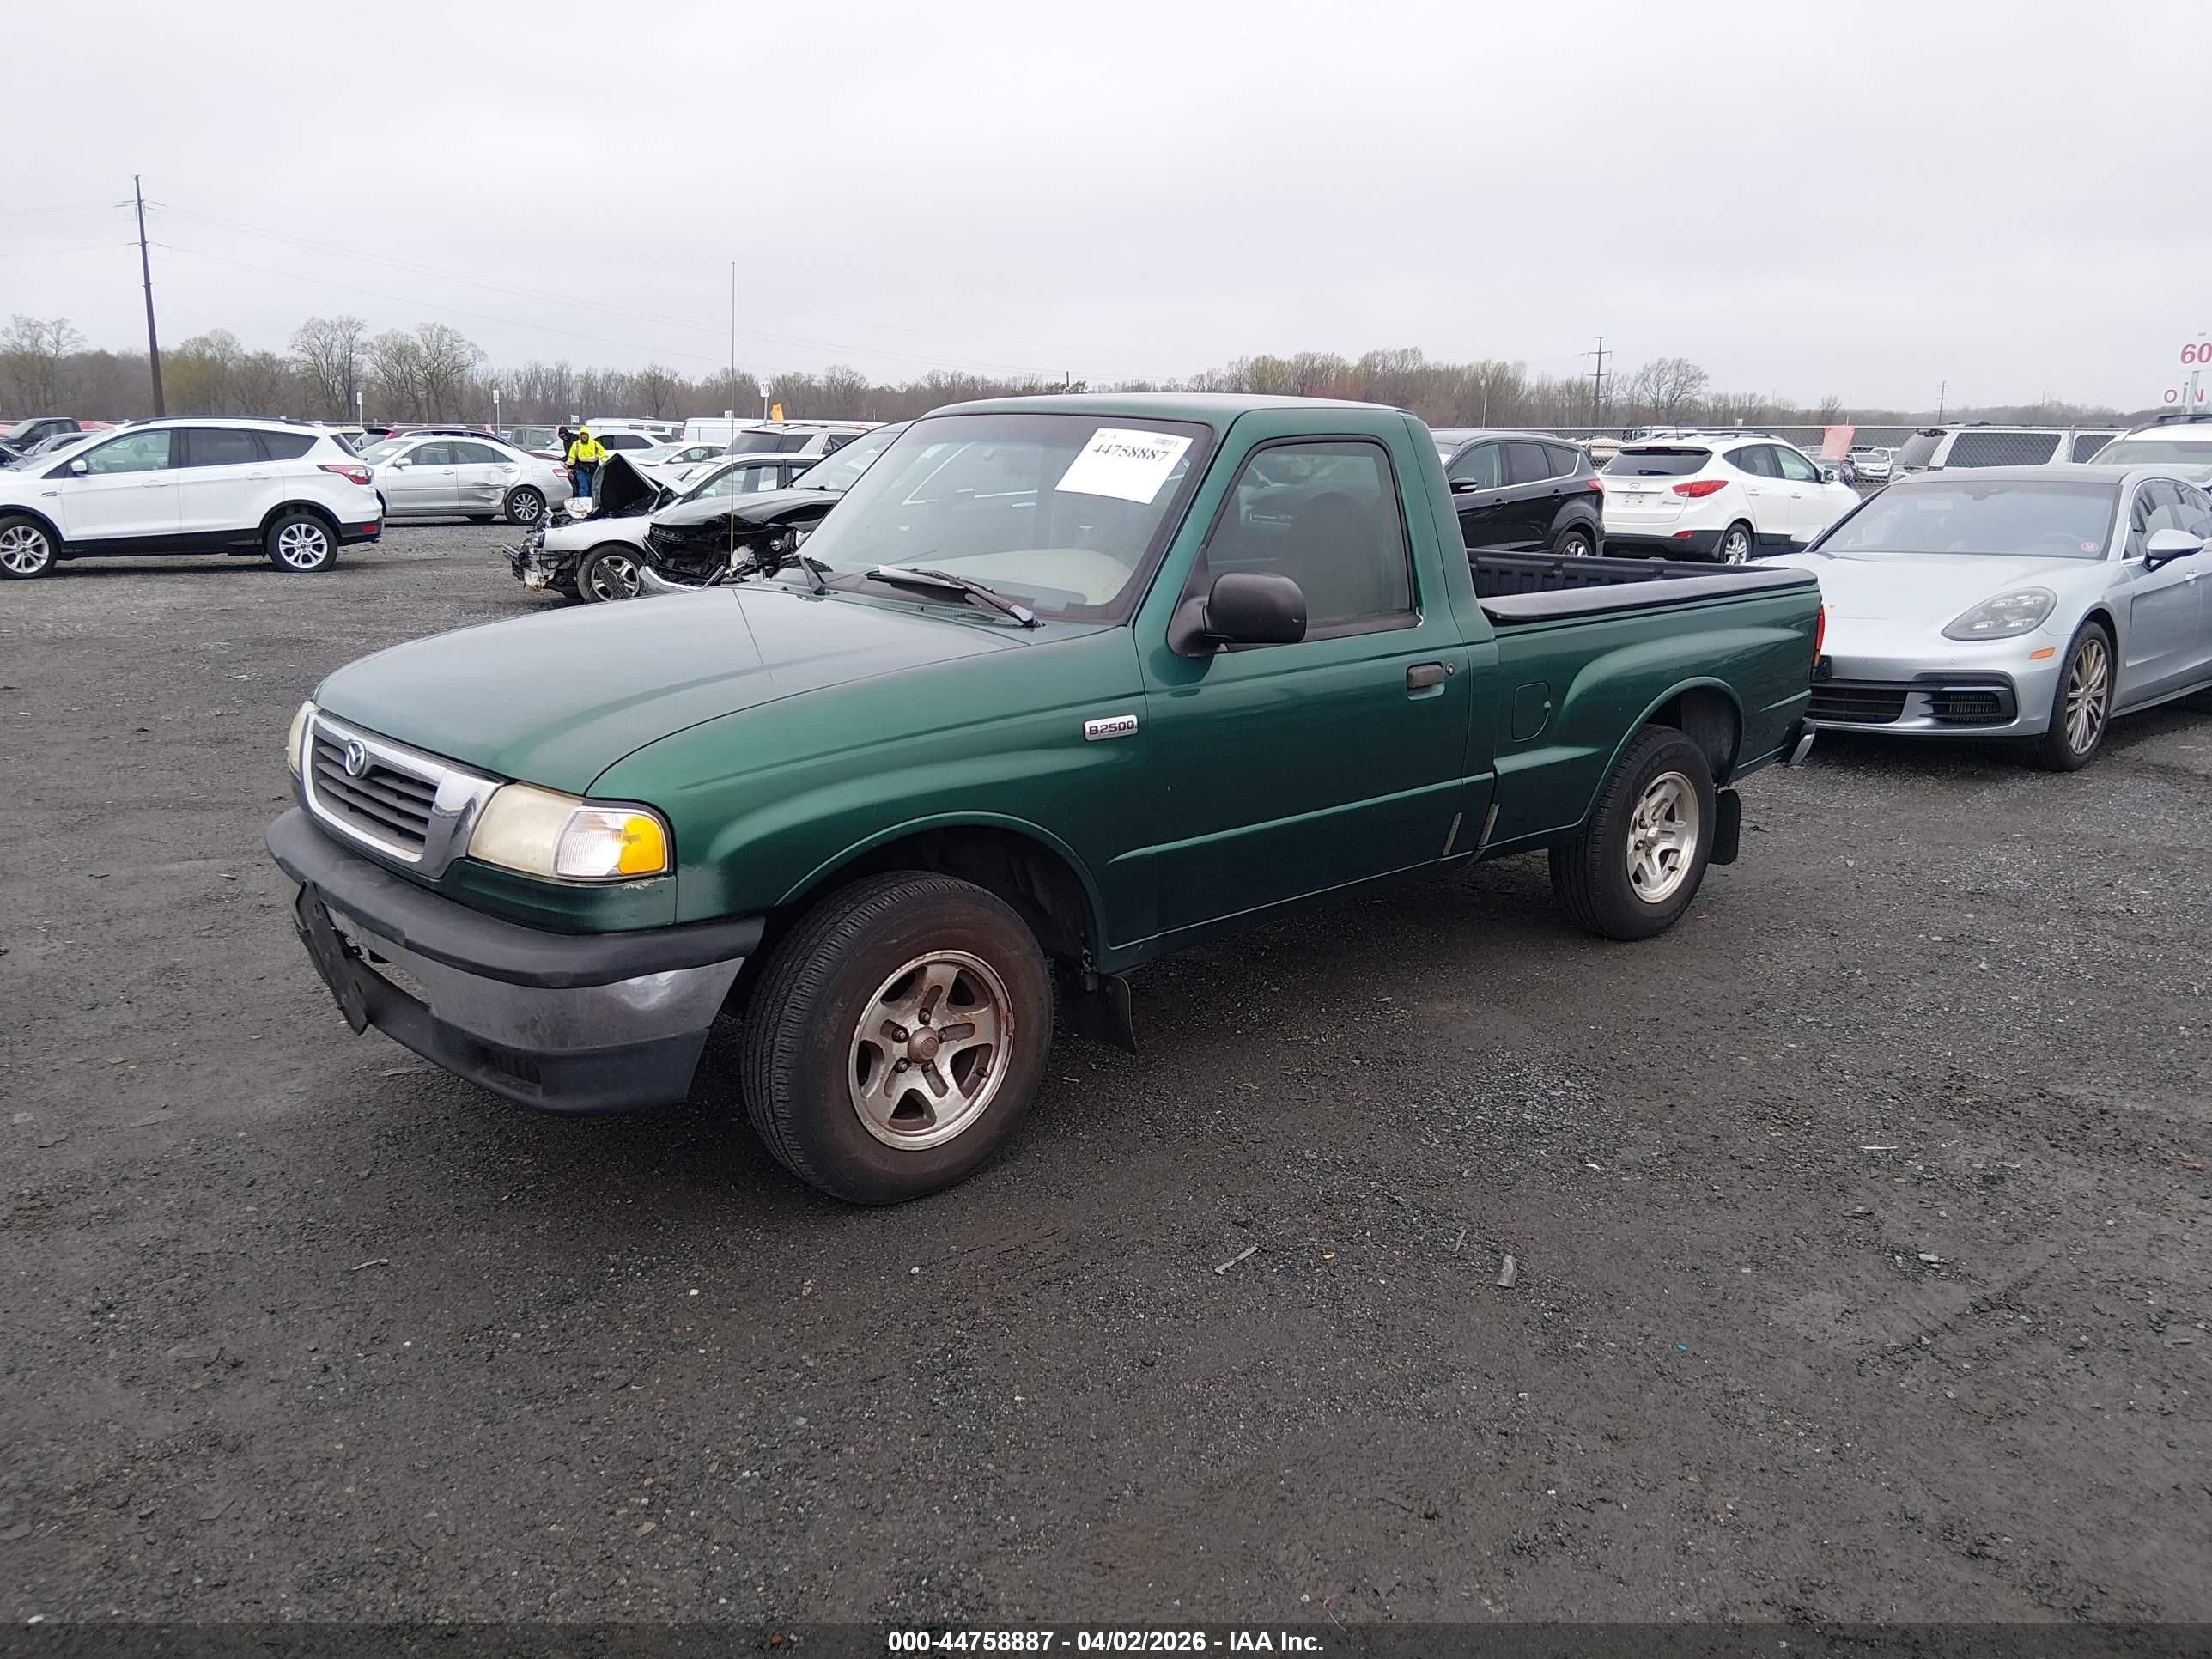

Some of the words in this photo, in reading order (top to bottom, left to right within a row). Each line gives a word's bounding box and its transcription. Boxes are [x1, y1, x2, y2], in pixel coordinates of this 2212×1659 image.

[761, 383, 769, 394] 70
[1092, 443, 1170, 462] 44758887
[1088, 720, 1135, 736] B2500
